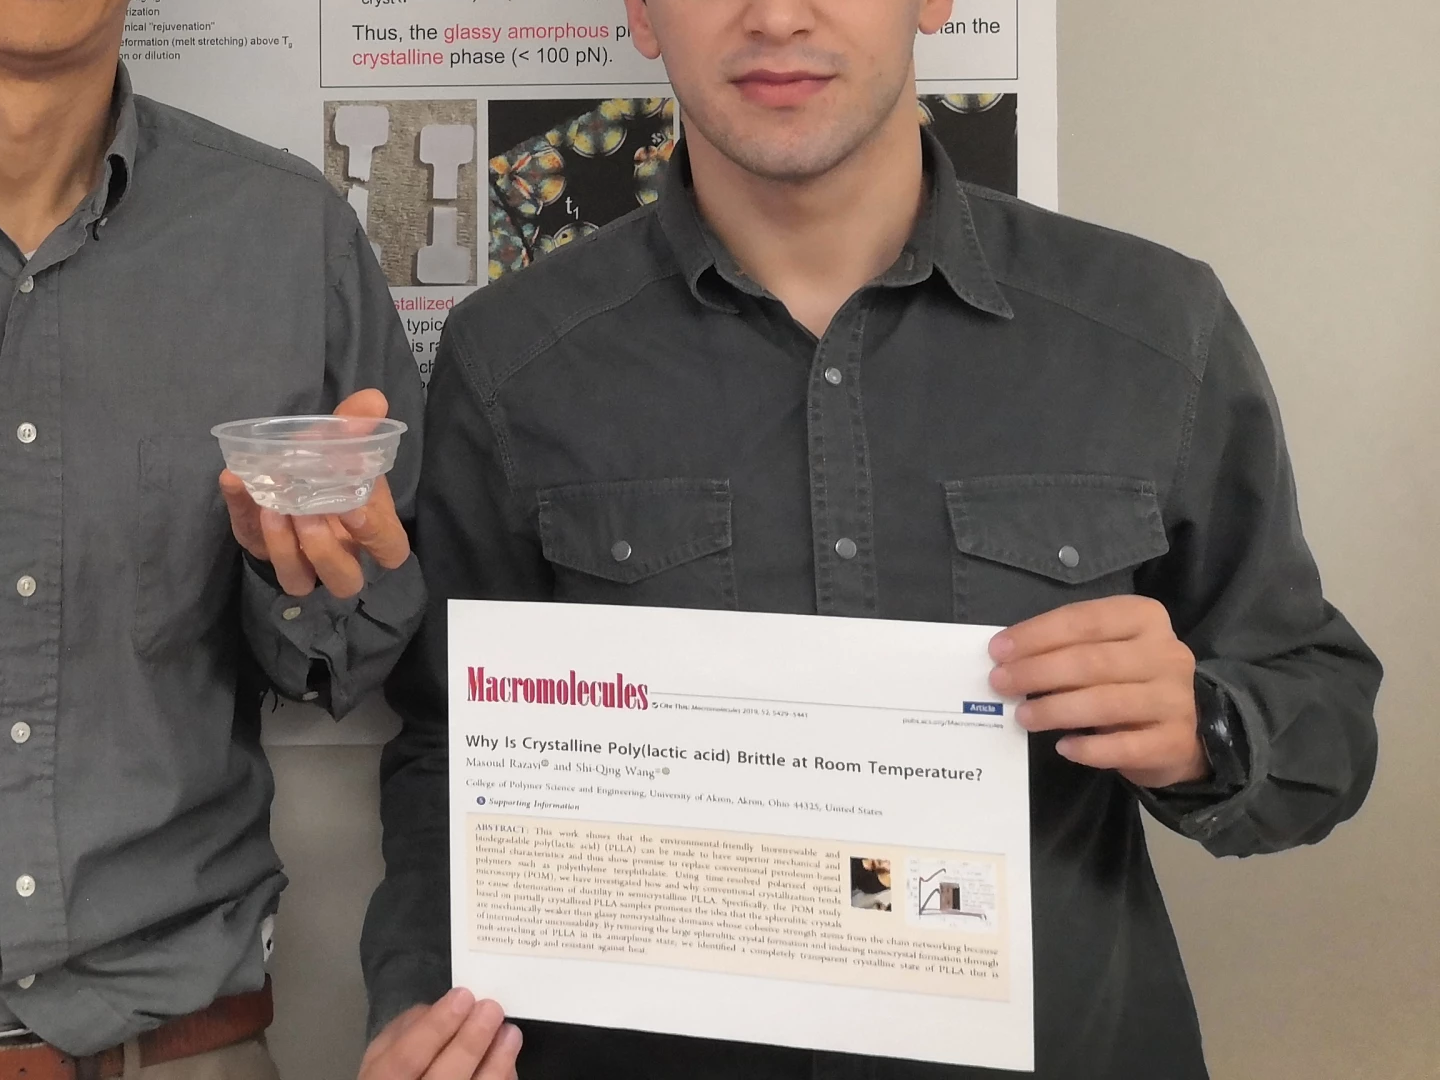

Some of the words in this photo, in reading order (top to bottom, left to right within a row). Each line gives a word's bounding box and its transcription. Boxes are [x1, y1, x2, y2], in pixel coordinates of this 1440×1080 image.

[351, 23, 402, 43] Thus,
[408, 23, 437, 40] the
[443, 22, 501, 44] glassy
[507, 21, 609, 42] amorphous
[352, 47, 443, 69] crystalline
[449, 47, 505, 68] phase
[536, 46, 569, 63] 100
[575, 45, 613, 67] pN).
[466, 665, 648, 710] Macromolecules
[969, 703, 996, 713] Article
[464, 733, 498, 751] Why
[504, 735, 516, 749] Is
[521, 736, 602, 753] Crystalline
[607, 741, 687, 759] Poly(lactic
[693, 747, 730, 764] acid)
[737, 750, 785, 767] Brittle
[791, 756, 807, 768] at
[814, 755, 861, 773] Room
[867, 760, 982, 781] Temperature?
[465, 756, 505, 768] Masoud
[509, 758, 541, 771] Razavi
[552, 761, 571, 772] and
[575, 762, 621, 778] Shi-Qing
[465, 778, 495, 788] College
[498, 780, 507, 788] of
[509, 780, 542, 791] Polymer
[545, 782, 575, 792] Science
[578, 785, 593, 794] and
[596, 786, 647, 798] Engineering,
[649, 789, 692, 802] University
[694, 793, 703, 801] of
[705, 793, 734, 804] Akron,
[736, 796, 765, 807] Akron,
[767, 798, 790, 808] Ohio
[793, 801, 821, 812] 44325,
[824, 803, 855, 814] United
[857, 806, 883, 815] States
[488, 797, 531, 809] Supporting
[533, 799, 579, 810] Information
